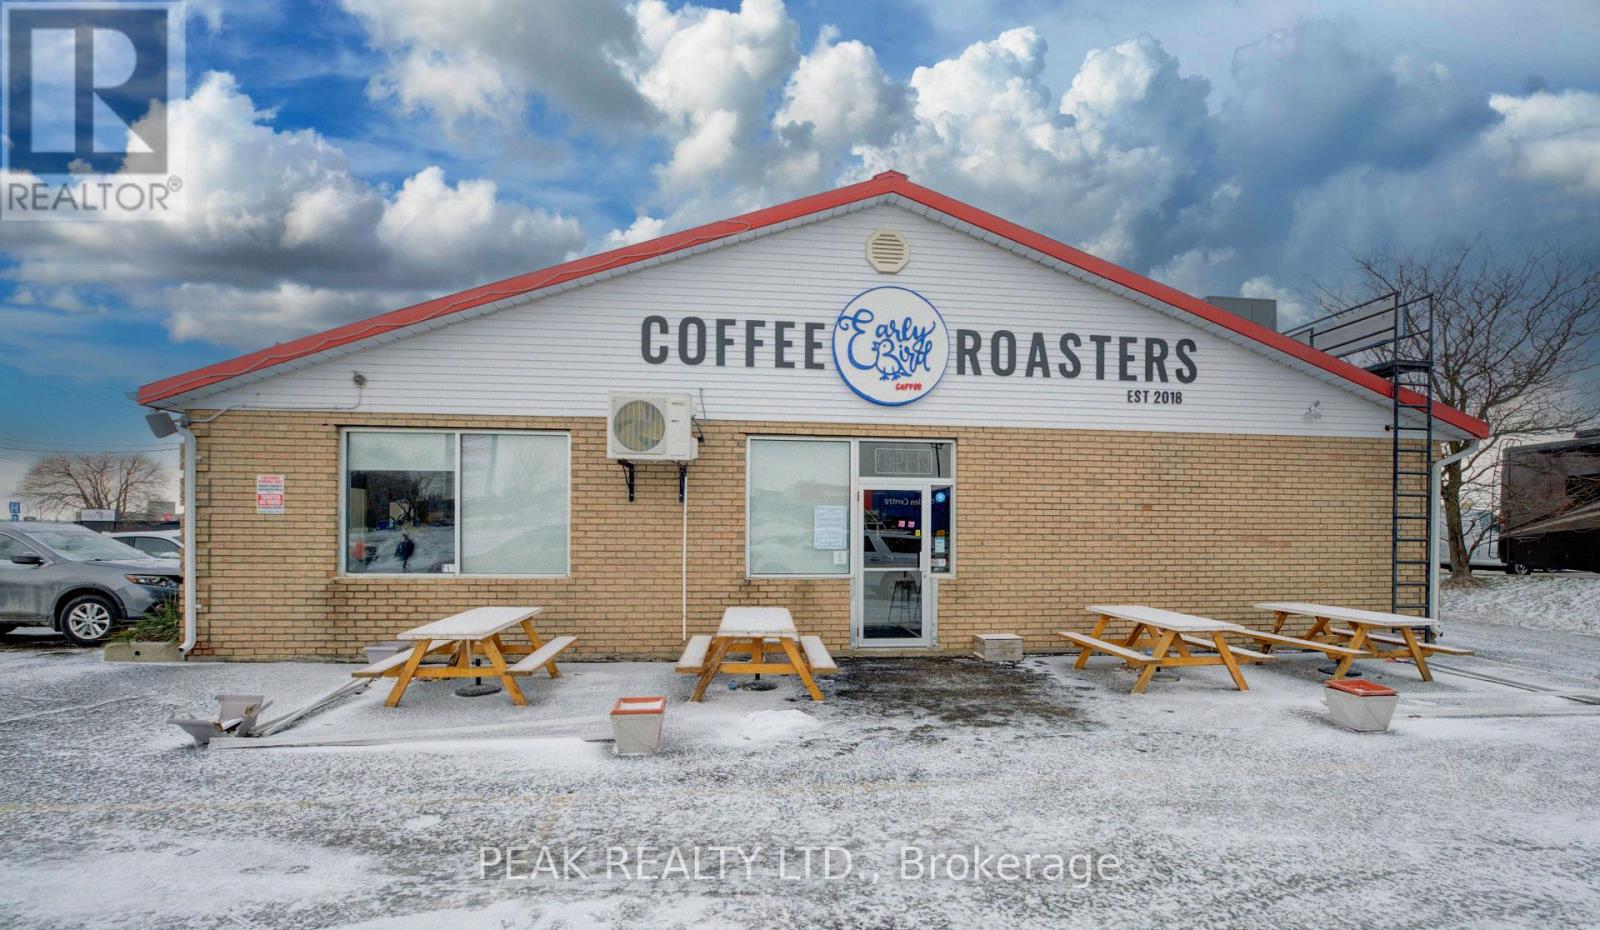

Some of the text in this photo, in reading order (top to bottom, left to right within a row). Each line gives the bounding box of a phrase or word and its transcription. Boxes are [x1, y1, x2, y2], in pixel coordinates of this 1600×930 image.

[641, 315, 825, 369] COFFEE
[839, 308, 936, 371] Early
[872, 338, 933, 379] Bird
[956, 329, 1198, 384] ROASTERS
[1127, 389, 1182, 404] EST 2018
